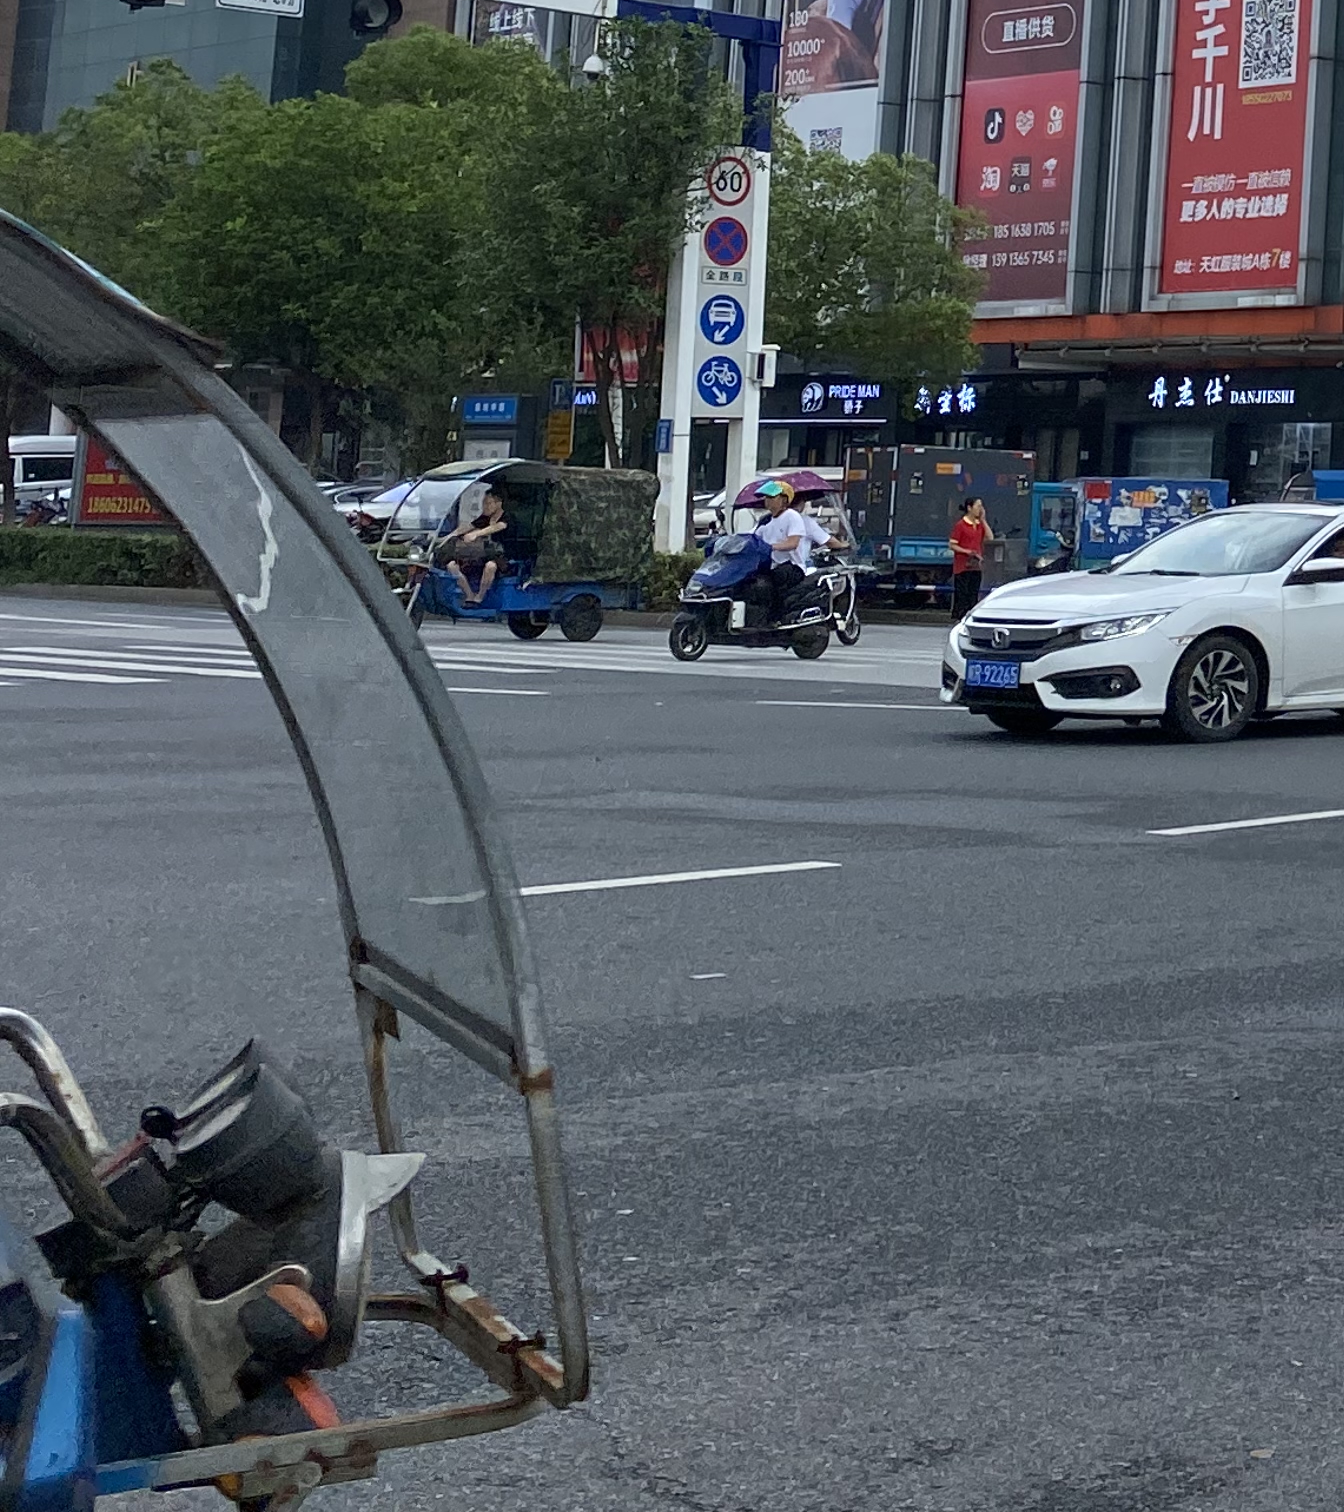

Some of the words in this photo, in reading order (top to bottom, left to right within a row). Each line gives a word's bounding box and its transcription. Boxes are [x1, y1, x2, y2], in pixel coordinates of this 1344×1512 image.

[1003, 16, 1054, 42] 直播供货
[716, 170, 743, 192] 60
[706, 269, 744, 283] 全路段
[829, 385, 856, 398] PRIDE
[857, 384, 880, 398] MAN
[1230, 389, 1295, 405] DANJIESHI
